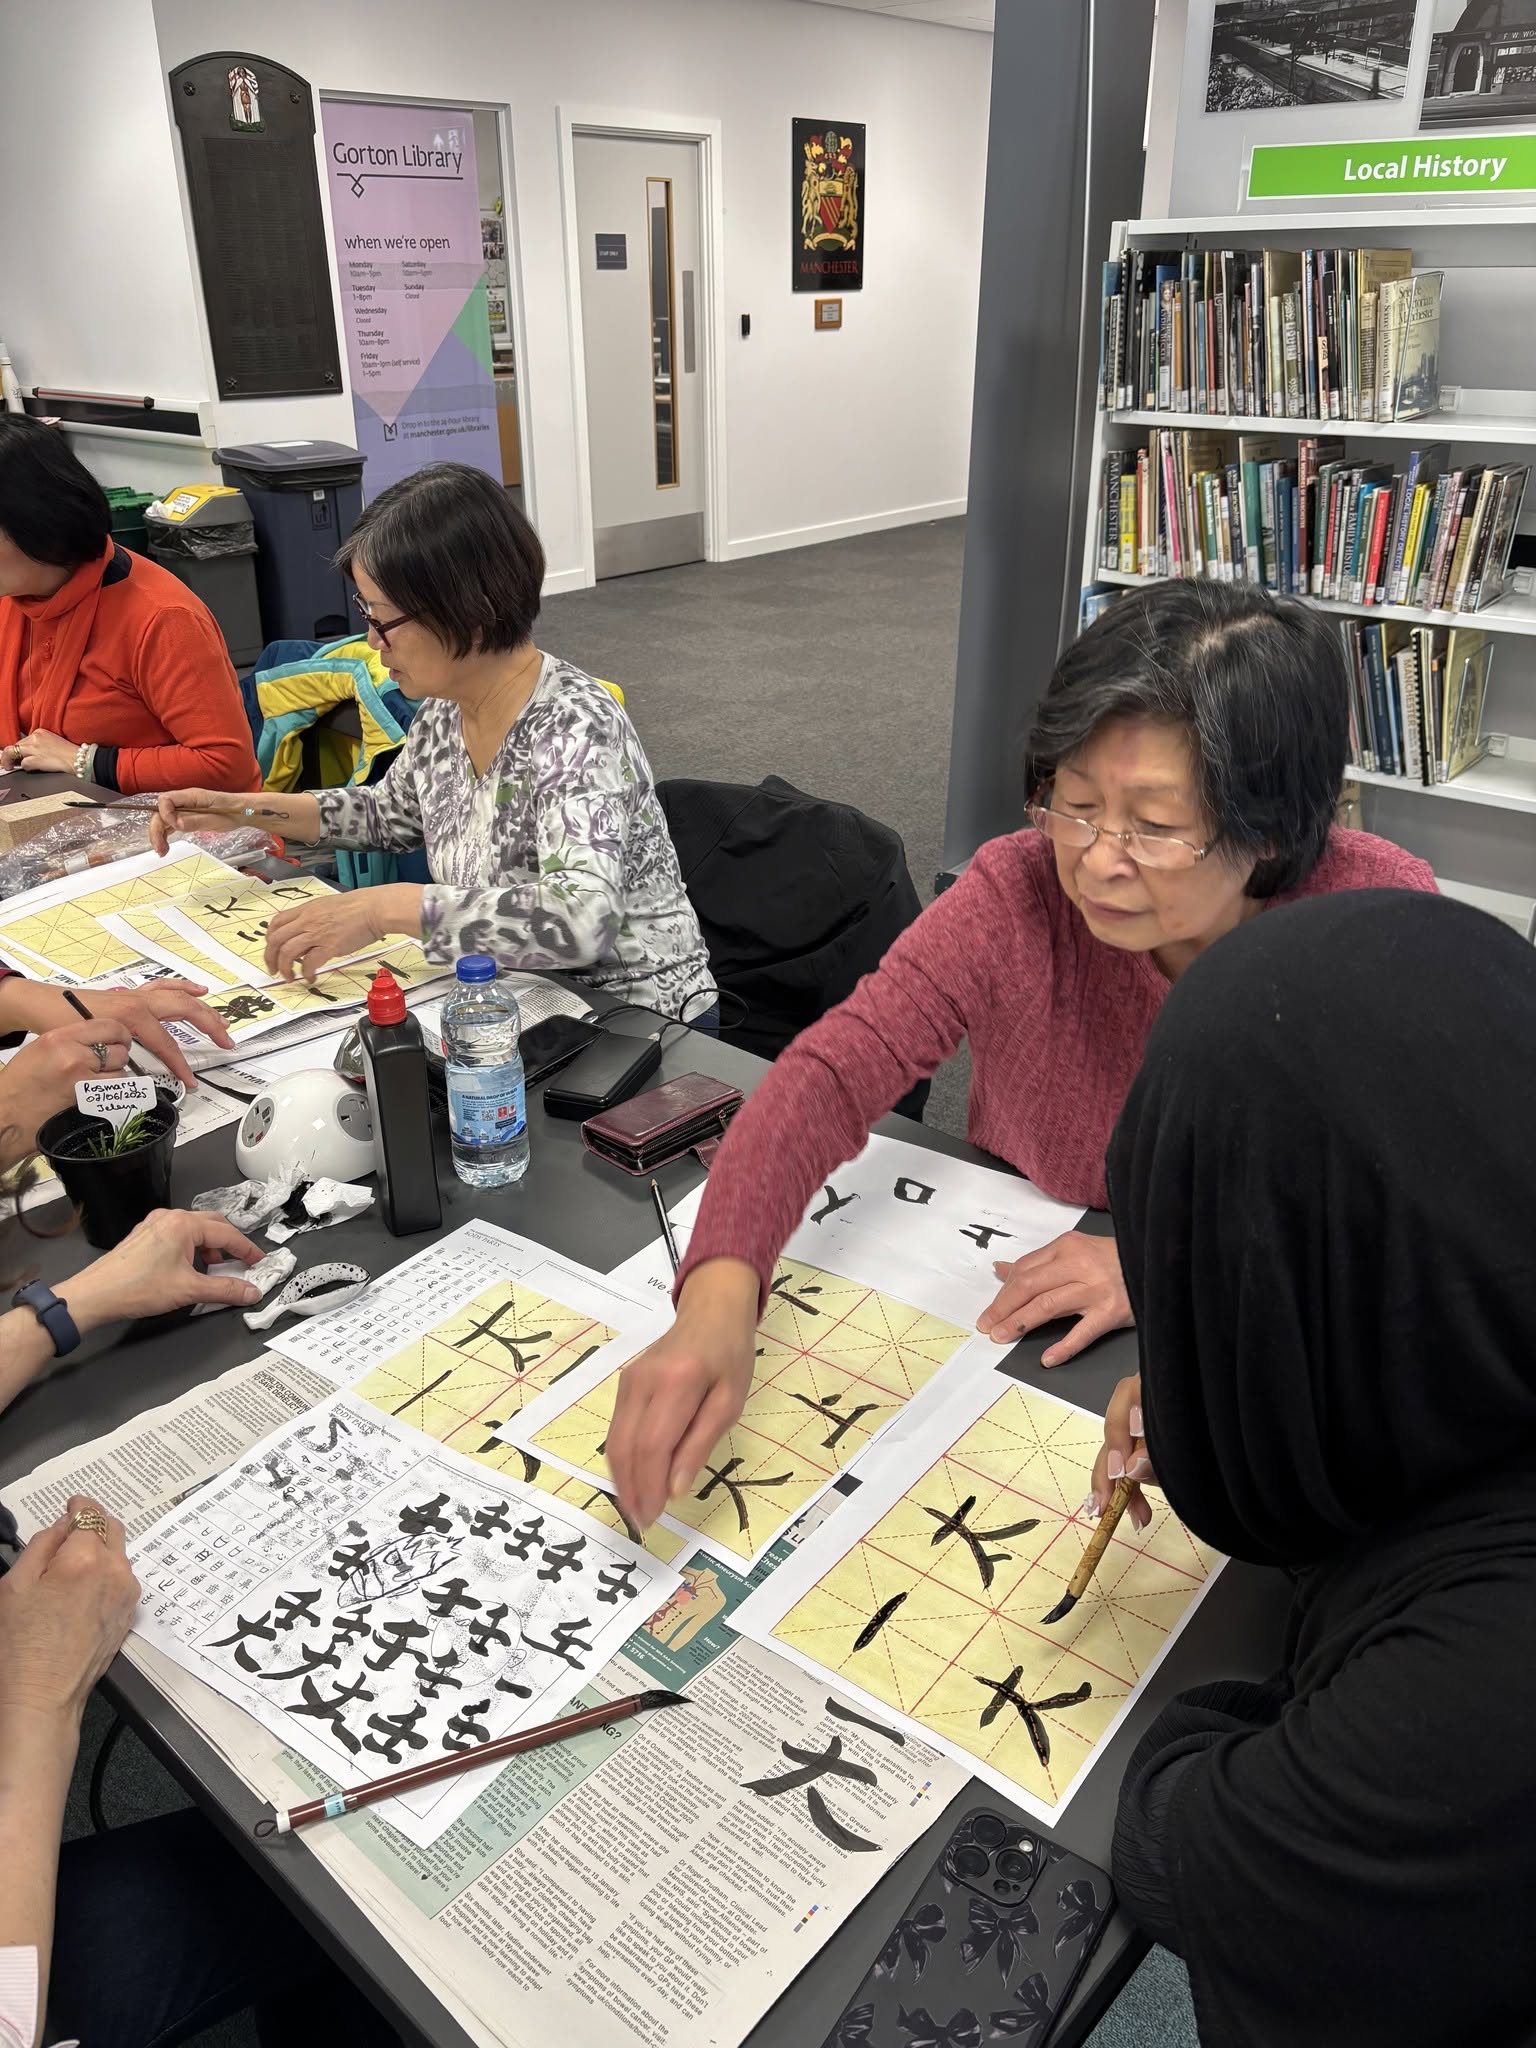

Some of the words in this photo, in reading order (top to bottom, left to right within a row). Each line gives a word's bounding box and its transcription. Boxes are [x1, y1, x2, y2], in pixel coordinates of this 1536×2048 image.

[333, 142, 398, 166] Gorton
[402, 144, 462, 174] Library
[1344, 155, 1408, 181] Local
[1412, 154, 1508, 182] History
[345, 234, 381, 249] when
[384, 234, 417, 249] we're
[419, 237, 451, 252] open
[349, 261, 373, 270] Monday
[401, 260, 427, 269] Saturday
[800, 260, 859, 274] MANCHESTER
[352, 284, 376, 293] Tuesday
[404, 283, 425, 292] Sunday
[354, 307, 387, 315] Wednesday
[357, 329, 384, 338] Thursday
[361, 352, 379, 361] Friday
[410, 423, 490, 439] manchester.gov.uk/libraries
[1108, 461, 1121, 542] MANCHESTER
[1402, 487, 1412, 511] LOCAL
[1345, 512, 1357, 544] FAMILY
[1397, 512, 1409, 541] HISTORY
[1403, 658, 1416, 726] MANCHESTER
[463, 1230, 481, 1240] BODY
[481, 1237, 500, 1247] PARTS
[647, 1275, 666, 1291] We
[251, 1373, 260, 1381] TO
[258, 1378, 274, 1390] SAVE
[271, 1388, 298, 1410] DERELICT
[257, 1370, 287, 1392] CHORLTON
[331, 1406, 353, 1421] BODY
[714, 1562, 744, 1584] Aneurysm
[629, 1646, 646, 1660] 5716
[671, 1863, 683, 1874] for
[679, 1870, 709, 1895] colorectal
[706, 1892, 728, 1911] cancer
[725, 1907, 736, 1916] at
[676, 1858, 687, 1868] Dr
[683, 1864, 705, 1882] Roger
[700, 1878, 732, 1904] Prudham,
[728, 1899, 753, 1920] Clinical
[750, 1917, 768, 1932] Lead
[613, 1925, 628, 1938] like
[624, 1934, 634, 1943] to
[629, 1940, 651, 1959] speak
[647, 1954, 658, 1964] to
[653, 1961, 669, 1975] you
[665, 1969, 686, 1987] about
[682, 1984, 693, 1993] it.
[618, 1919, 652, 1948] symptoms,
[647, 1944, 665, 1959] your
[661, 1954, 675, 1967] GP
[671, 1962, 692, 1981] would
[688, 1978, 710, 1997] really
[651, 1933, 666, 1947] had
[661, 1944, 676, 1957] any
[673, 1952, 684, 1962] of
[680, 1958, 700, 1976] these
[601, 1938, 642, 1974] conversations
[638, 1971, 657, 1989] every
[654, 1984, 671, 2000] day,
[668, 1996, 683, 2010] and
[680, 2007, 694, 2020] can
[608, 1932, 619, 1942] be
[615, 1938, 654, 1972] embarrassed
[655, 1973, 672, 1988] GPs
[669, 1984, 687, 2001] have
[683, 1997, 704, 2015] these
[563, 1976, 596, 2005] symptoms
[575, 1964, 609, 1993] symptoms
[604, 1988, 615, 1998] of
[611, 1995, 632, 2013] bowel
[627, 2011, 652, 2033] cancer,
[583, 1958, 597, 1970] For
[594, 1967, 611, 1983] more
[608, 1979, 643, 2011] information
[639, 2007, 660, 2026] about
[656, 2023, 670, 2035] the
